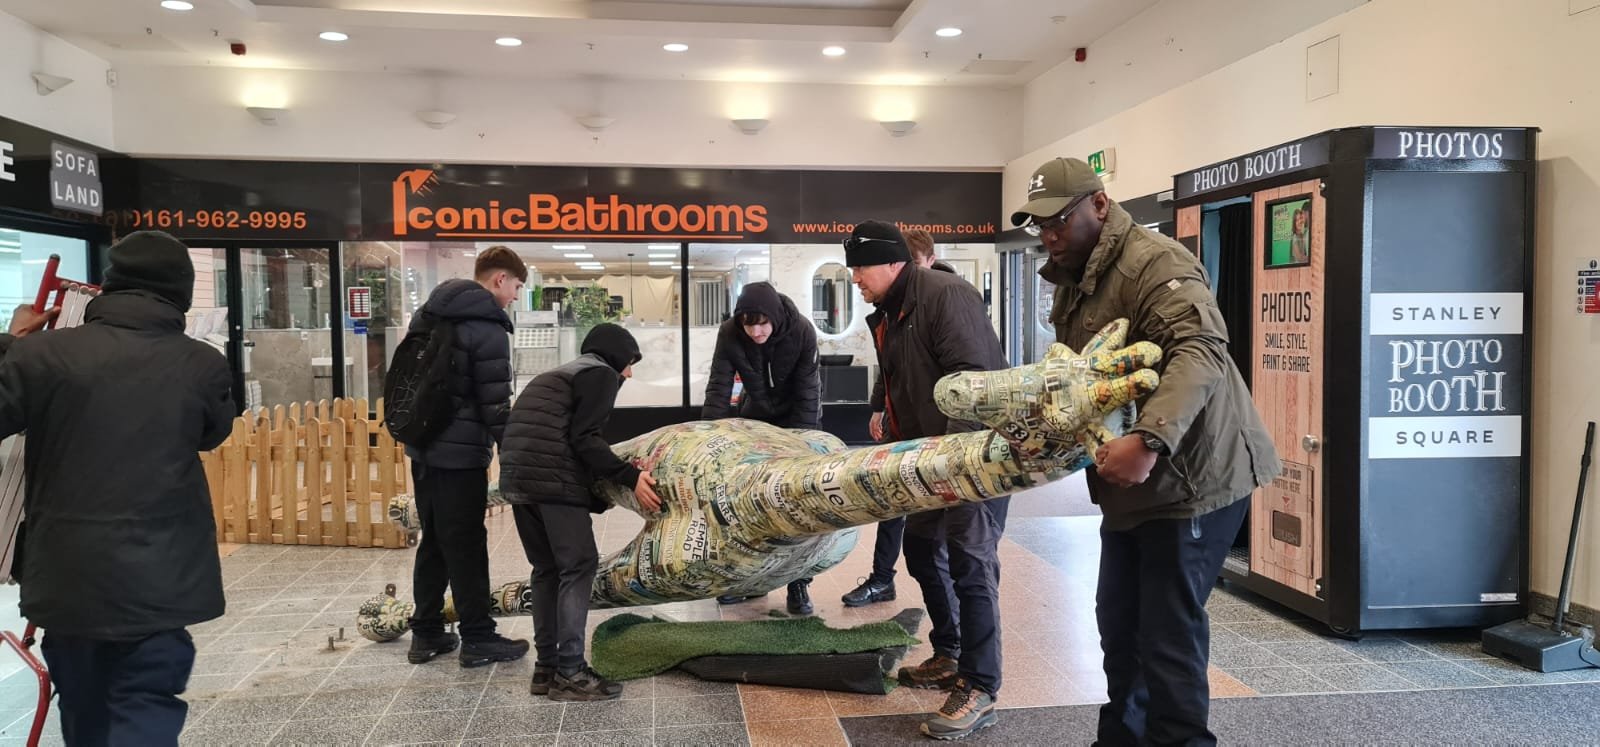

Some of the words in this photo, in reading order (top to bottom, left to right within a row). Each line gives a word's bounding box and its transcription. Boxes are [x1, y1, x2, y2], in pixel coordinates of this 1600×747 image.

[1397, 131, 1503, 158] PHOTOS
[54, 150, 97, 177] SOFA
[1193, 162, 1239, 192] PHOTO
[1244, 143, 1303, 180] BOOTH
[54, 180, 100, 207] LAND
[1261, 291, 1312, 323] PHOTOS
[1392, 307, 1502, 321] STANLEY
[1264, 332, 1286, 351] SMILE,
[1286, 333, 1309, 352] STYLE,
[1262, 353, 1281, 371] PRINT
[1288, 355, 1311, 373] SHARE
[1387, 339, 1503, 383] PHOTO
[1387, 370, 1508, 413] BOOTH
[1396, 430, 1494, 448] SQUARE
[822, 460, 847, 507] Sale
[900, 463, 913, 487] ROAD
[716, 484, 735, 523] FRIARS
[683, 519, 699, 552] ROAD
[691, 517, 708, 561] TEMPLE
